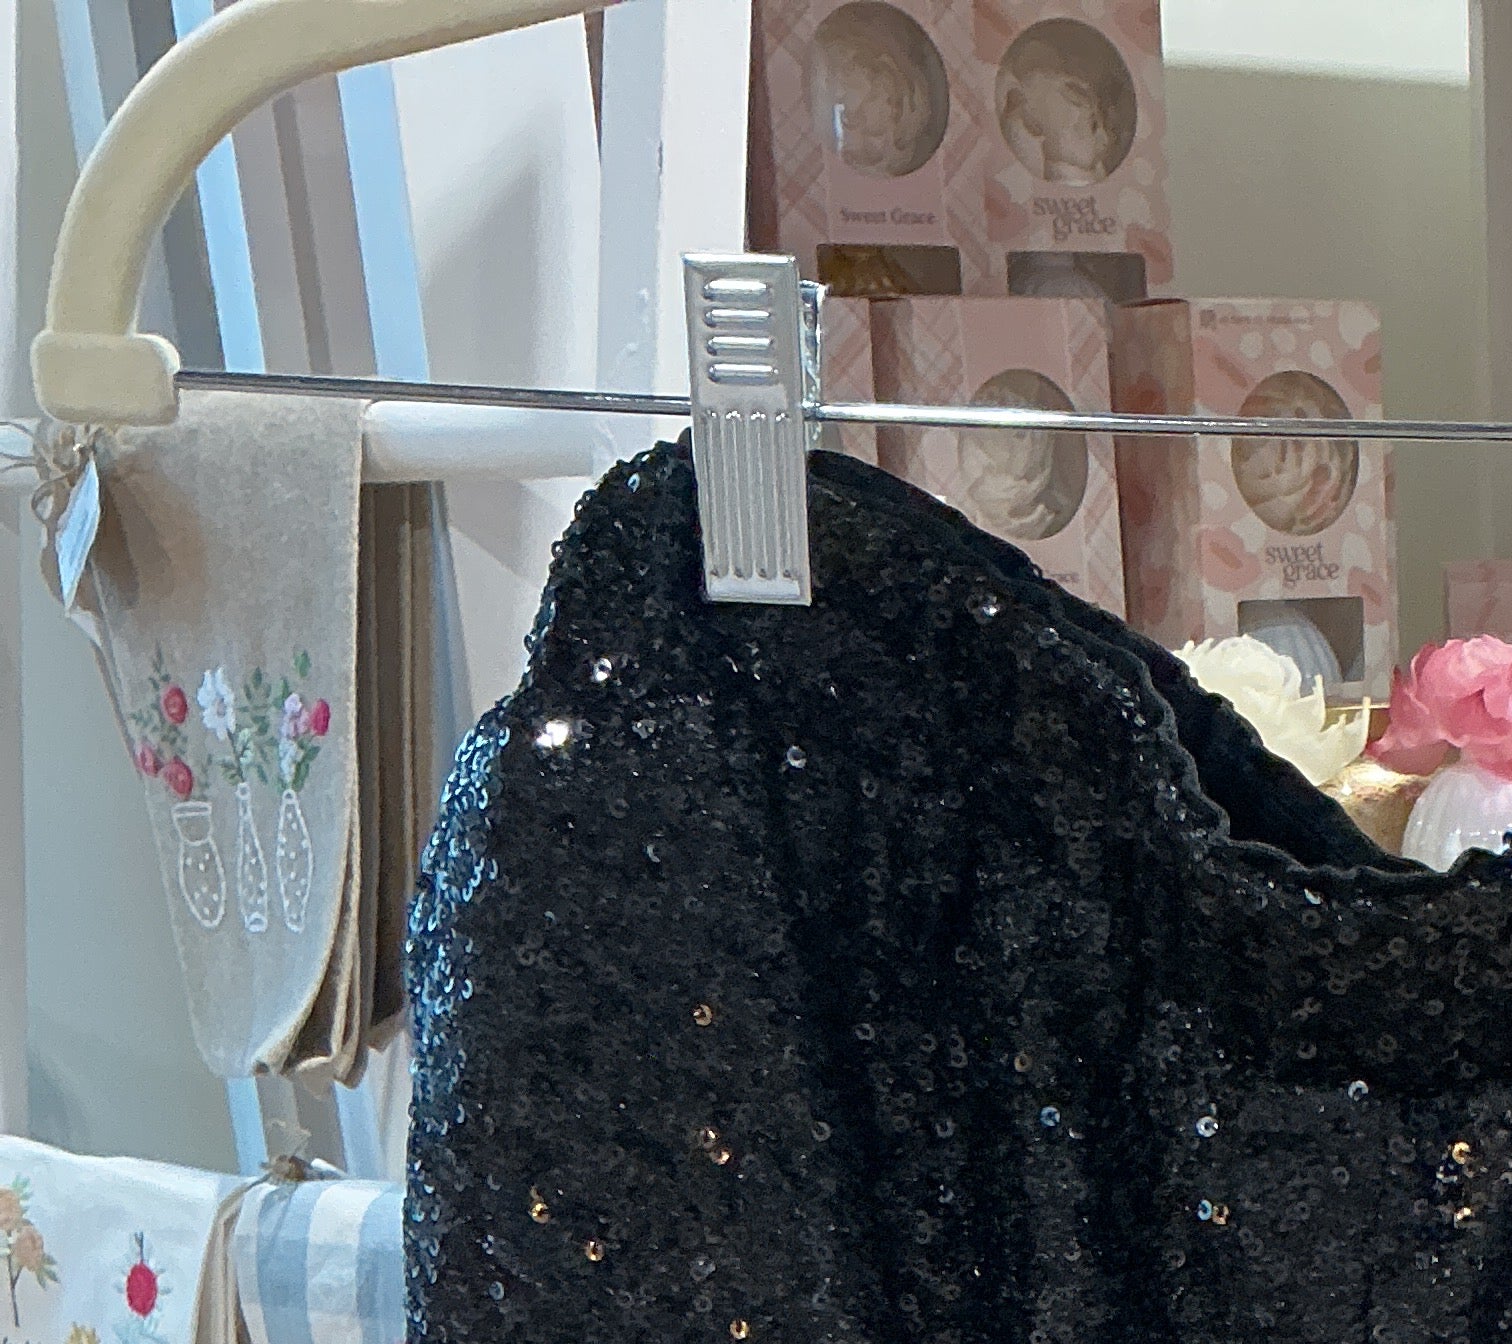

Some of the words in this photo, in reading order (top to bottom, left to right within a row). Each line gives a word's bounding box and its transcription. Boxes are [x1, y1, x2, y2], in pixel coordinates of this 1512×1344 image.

[839, 207, 886, 224] Sweet
[890, 206, 936, 225] Grace
[1032, 196, 1097, 215] sweet
[1052, 216, 1116, 242] grace
[1264, 542, 1324, 563] sweet
[1282, 561, 1340, 587] grace
